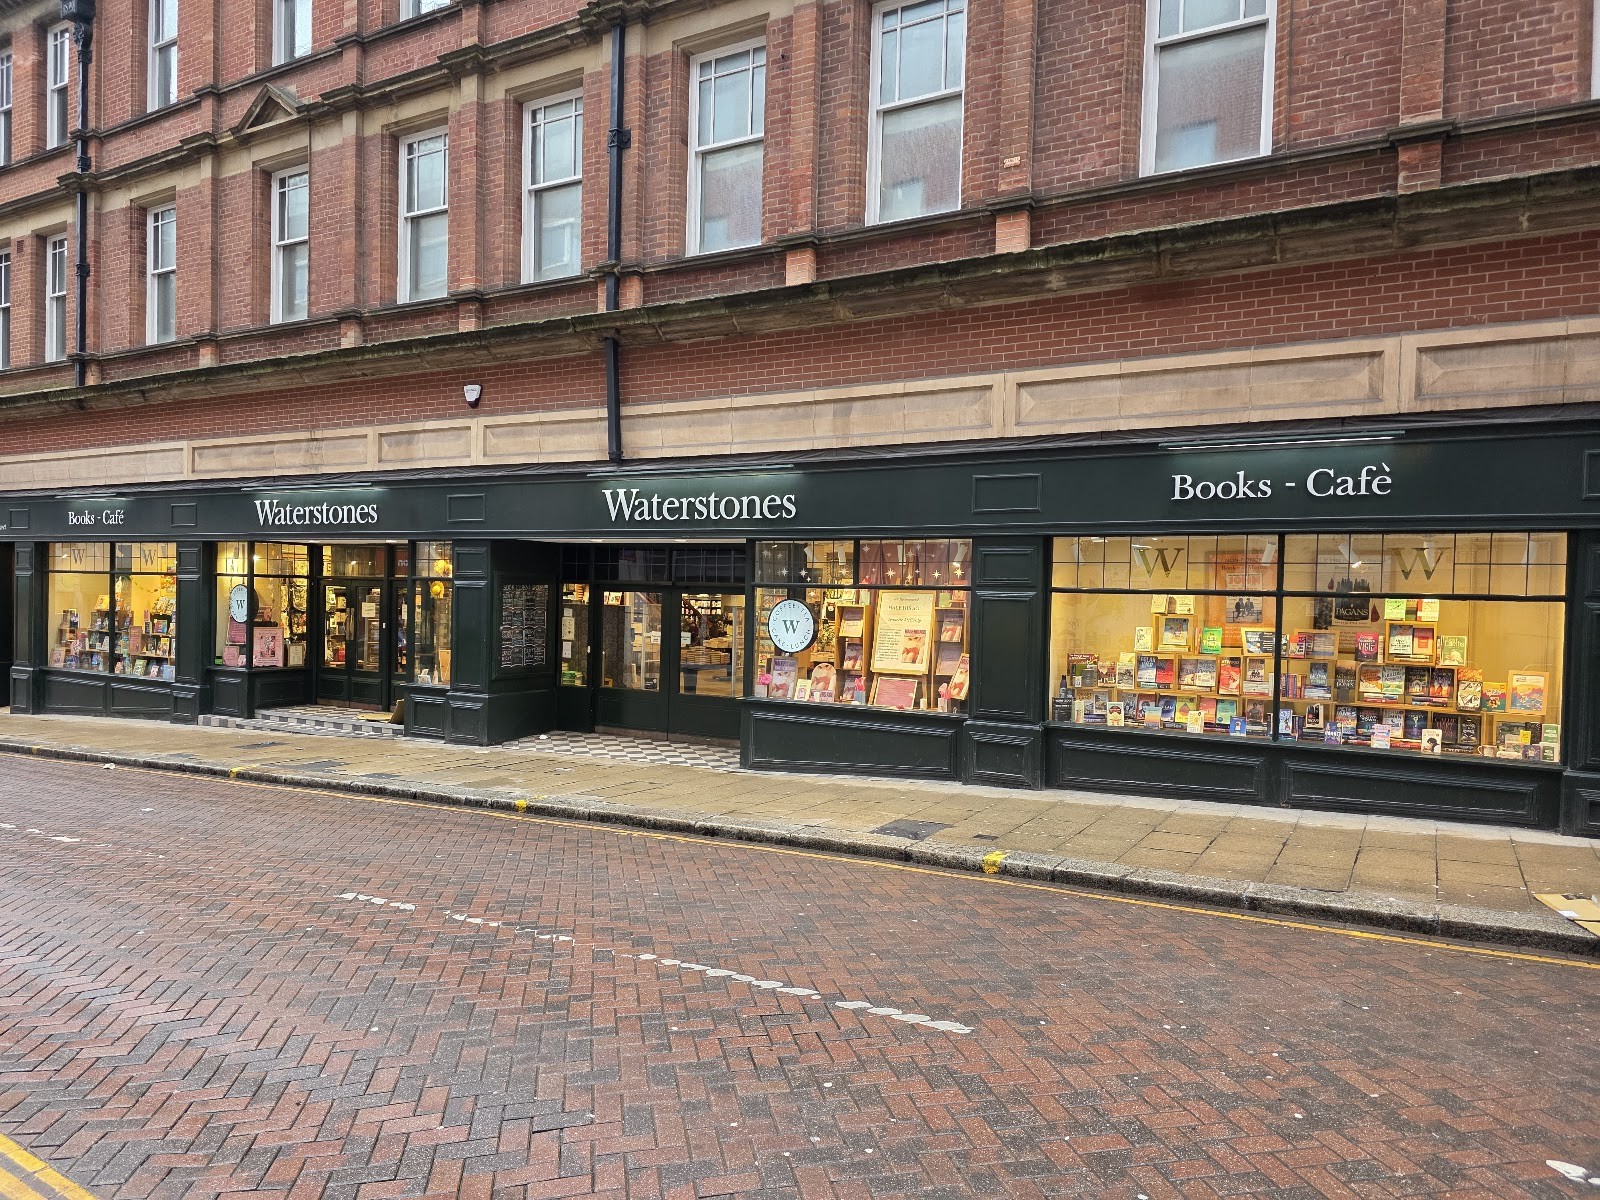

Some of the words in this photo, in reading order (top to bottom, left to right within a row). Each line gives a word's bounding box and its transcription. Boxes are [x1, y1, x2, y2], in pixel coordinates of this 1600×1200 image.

[1170, 470, 1272, 500] Books
[254, 499, 378, 526] Waterstones
[602, 488, 797, 522] Waterstones
[67, 509, 95, 525] Books
[103, 509, 124, 525] Café
[71, 548, 86, 565] W
[142, 549, 157, 567] W
[1133, 547, 1185, 578] W
[1387, 547, 1451, 580] W
[236, 599, 246, 610] W
[772, 602, 796, 621] COFFEE
[1335, 607, 1369, 616] PAGANS
[800, 608, 810, 623] TEA
[781, 619, 801, 634] W
[790, 629, 811, 650] LUNCH
